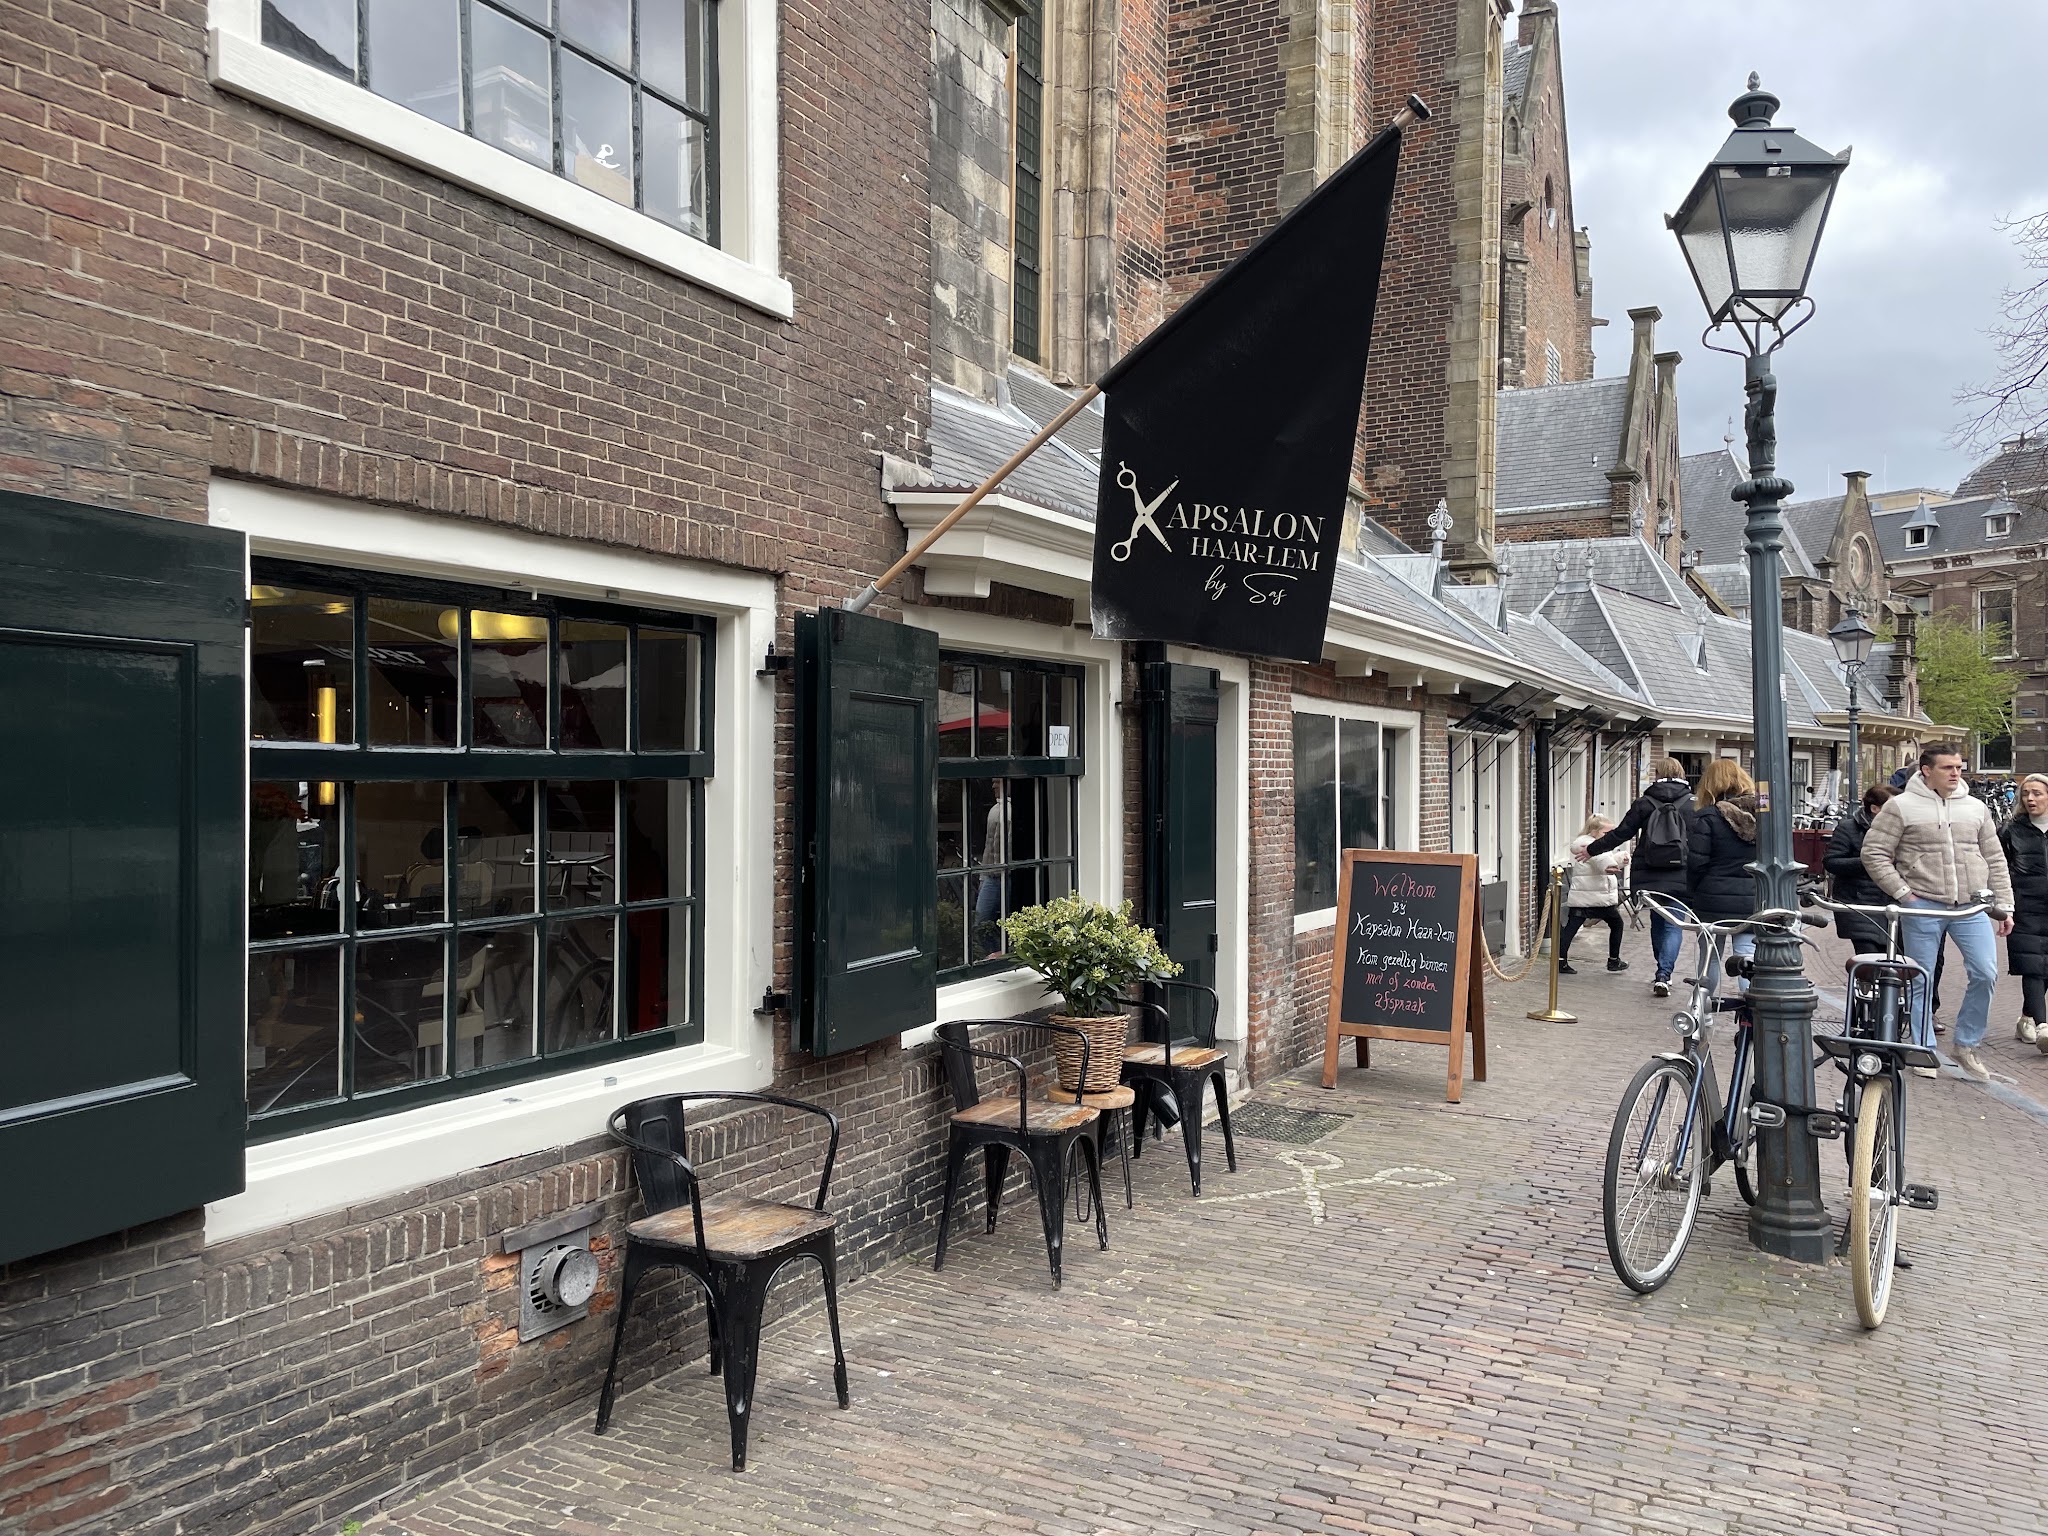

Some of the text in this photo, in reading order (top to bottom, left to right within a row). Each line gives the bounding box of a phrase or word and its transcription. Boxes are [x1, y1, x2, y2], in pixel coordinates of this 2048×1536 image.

[1190, 536, 1321, 572] HAAR-LEM
[1204, 564, 1298, 606] by Sas
[1373, 872, 1436, 898] Welkom
[1351, 912, 1402, 940] Kapsalon
[1356, 946, 1448, 974] Kom gezellig binnen
[1388, 971, 1400, 992] of
[1374, 990, 1427, 1015] afspraak
